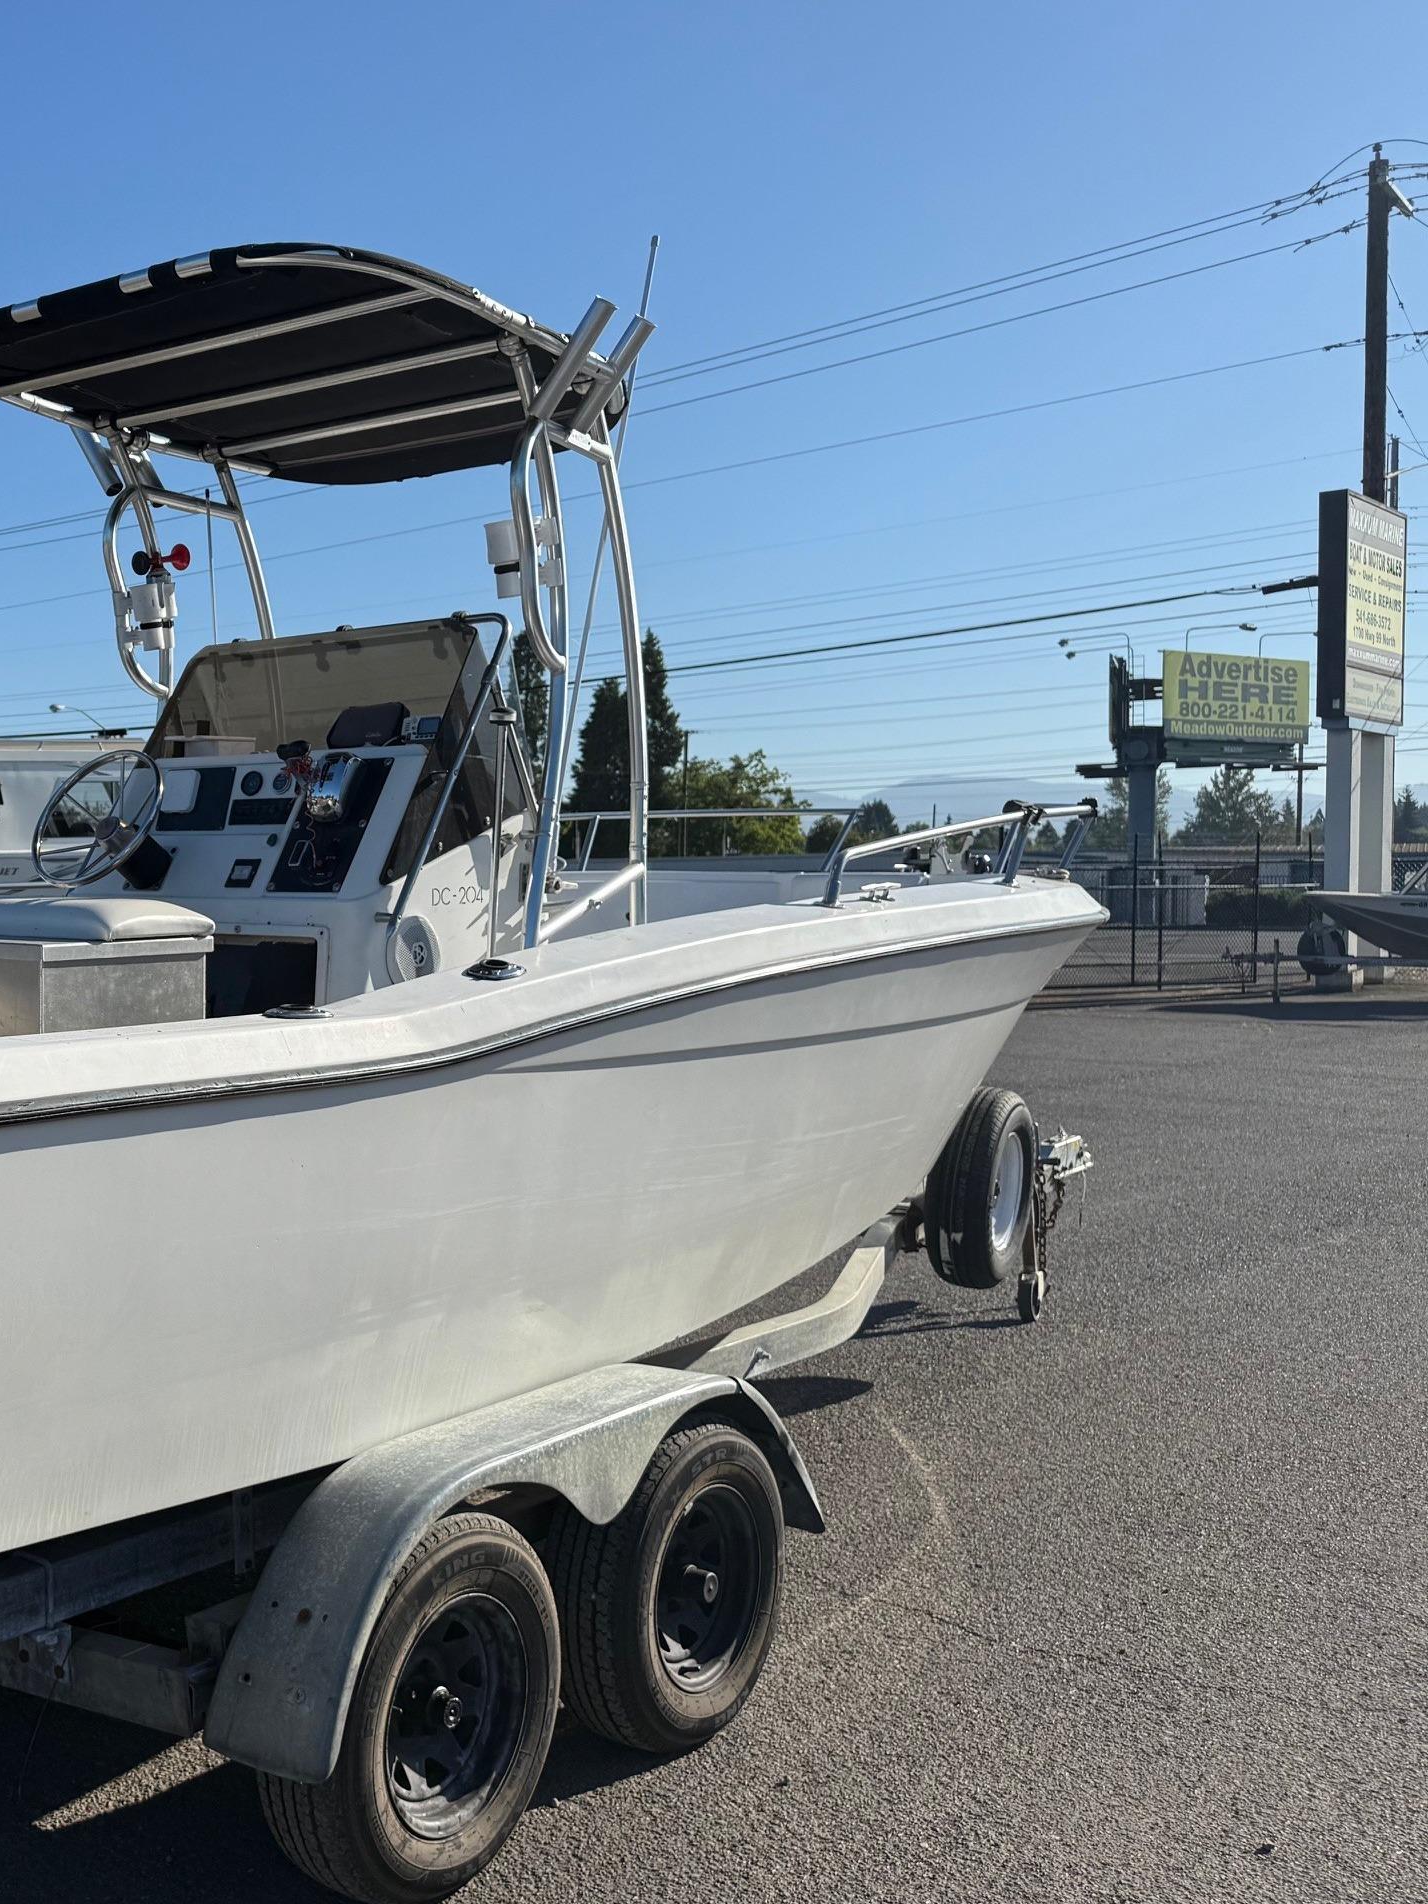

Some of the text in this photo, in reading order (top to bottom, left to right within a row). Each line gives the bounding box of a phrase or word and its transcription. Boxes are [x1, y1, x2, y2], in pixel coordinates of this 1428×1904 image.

[1348, 507, 1404, 547] MAXXUM MARINE
[1349, 542, 1363, 563] BOAT
[1368, 549, 1386, 572] MOTOR
[1386, 559, 1403, 578] SALES
[1348, 583, 1372, 604] SERVICE
[1378, 593, 1402, 613] REPAIRS
[1365, 628, 1375, 644] Hwy
[1376, 631, 1382, 644] 99
[1382, 633, 1396, 648] North
[1178, 653, 1298, 685] Advertise
[1178, 679, 1298, 707] HERE
[1171, 720, 1304, 739] MeadowOutdoor.com
[431, 885, 484, 907] DC-204
[431, 1550, 486, 1589] KING
